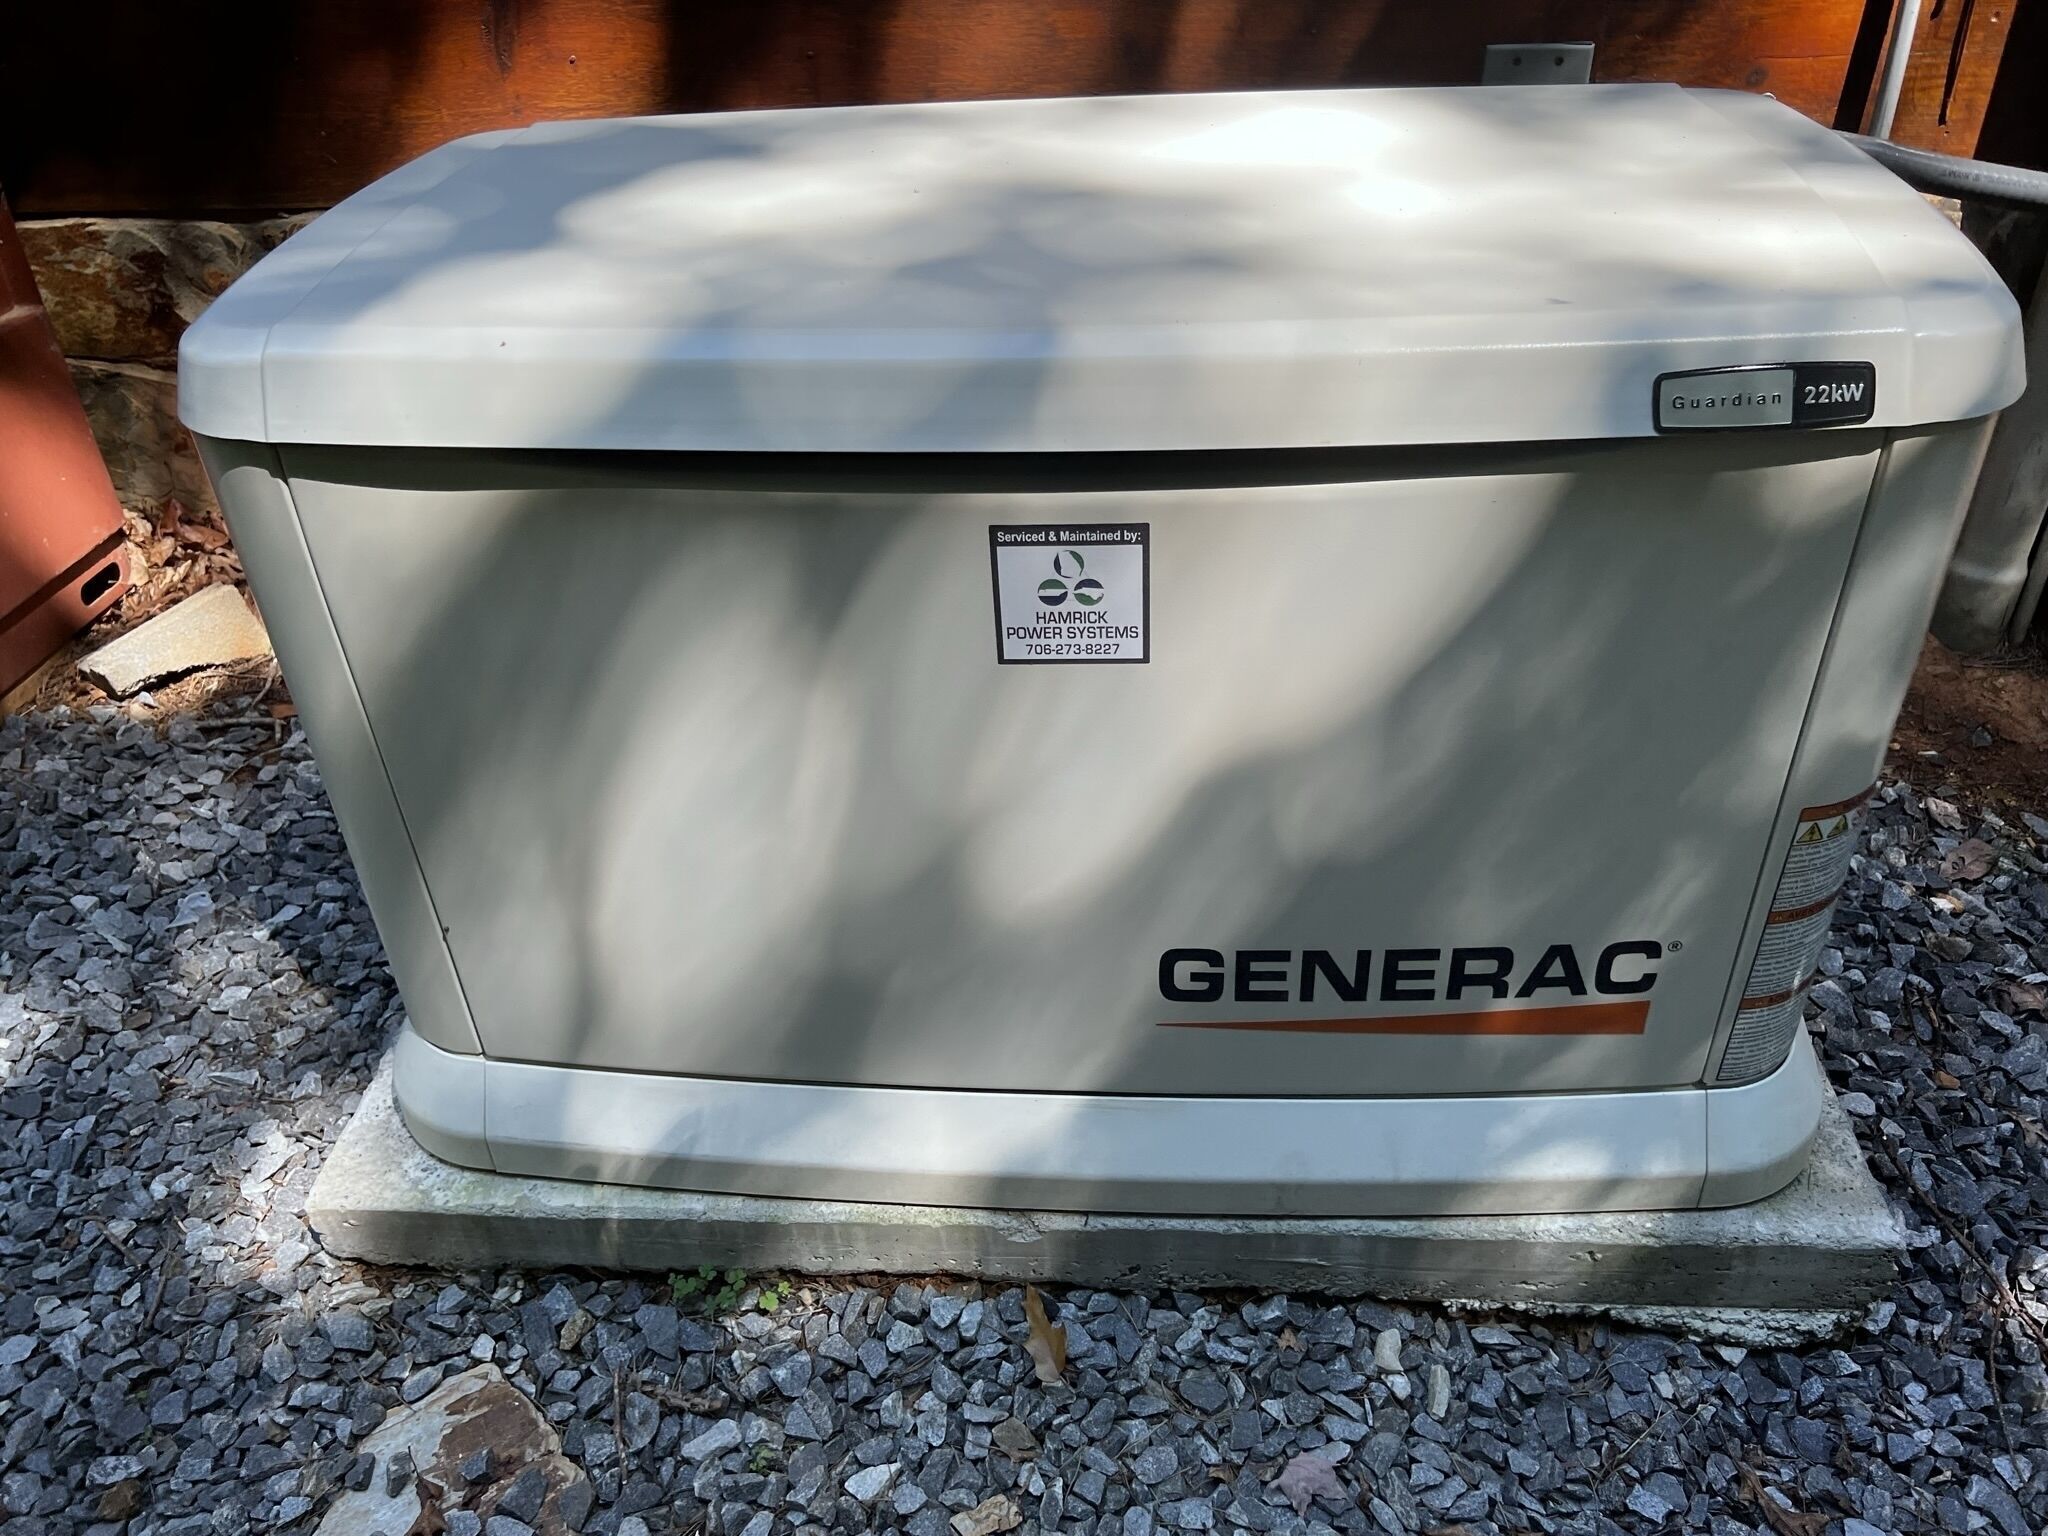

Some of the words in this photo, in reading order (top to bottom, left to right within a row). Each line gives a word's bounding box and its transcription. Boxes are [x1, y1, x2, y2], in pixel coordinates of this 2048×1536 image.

[1672, 391, 1781, 410] Guardian
[1804, 383, 1864, 405] 22kW
[997, 531, 1045, 542] Serviced
[1048, 531, 1057, 541] &
[1060, 530, 1121, 541] Maintained
[1124, 530, 1142, 543] by:
[1036, 611, 1108, 624] HAMRICK
[1007, 626, 1063, 639] POWER
[1067, 626, 1139, 639] SYSTEMS
[1026, 643, 1120, 655] 706-273-8227
